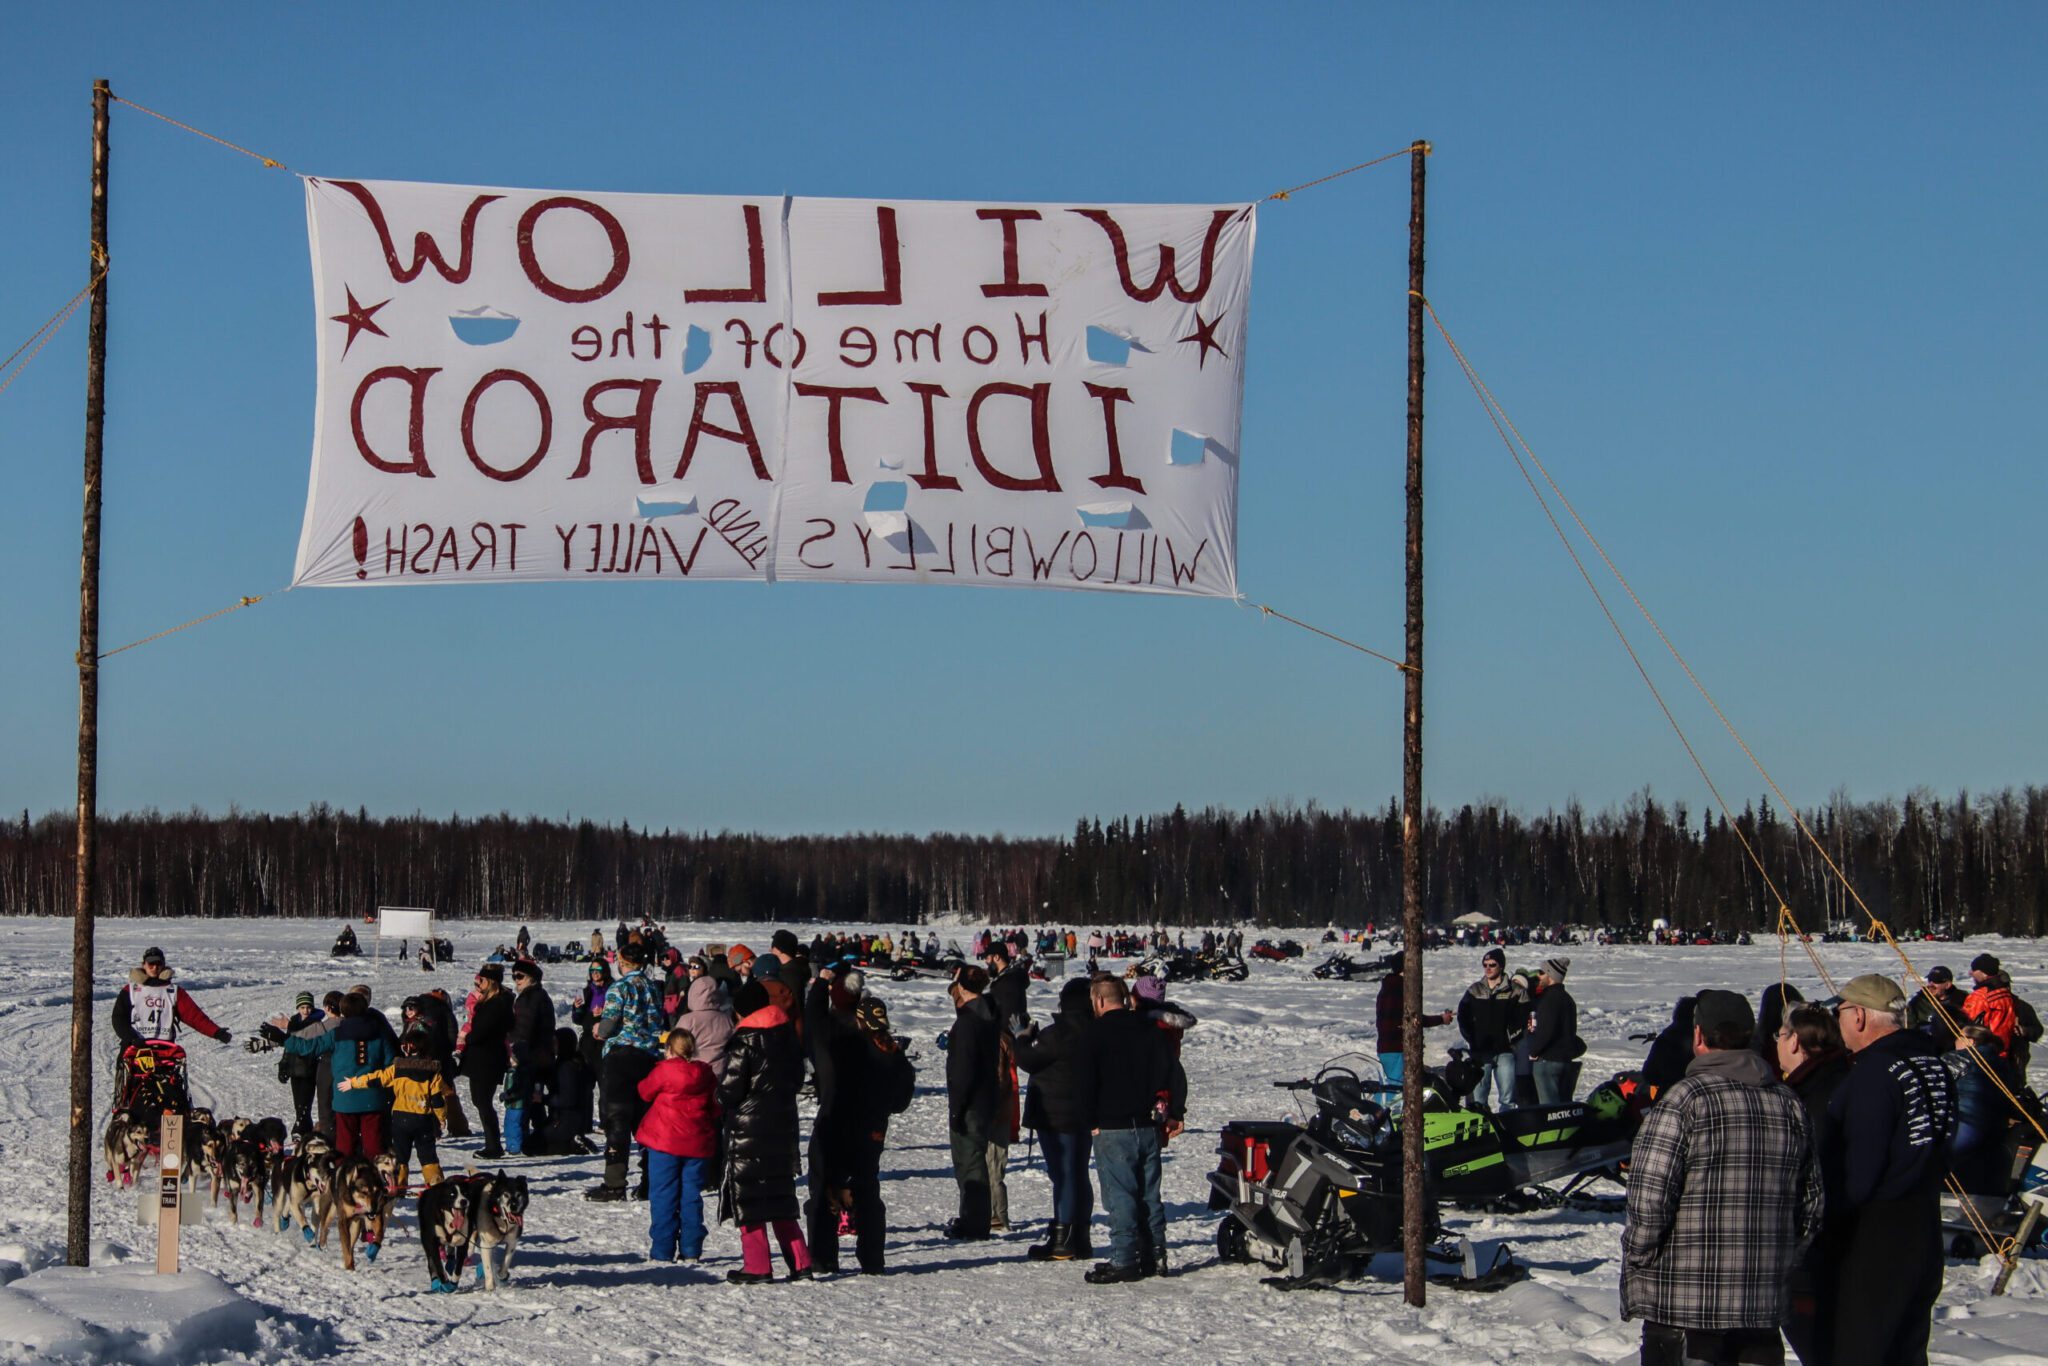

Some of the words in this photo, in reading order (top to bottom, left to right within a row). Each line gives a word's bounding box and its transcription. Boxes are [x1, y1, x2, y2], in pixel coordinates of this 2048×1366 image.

[145, 999, 165, 1008] GCI
[1547, 1110, 1571, 1121] ARCTIC
[162, 1196, 176, 1205] TRAIL
